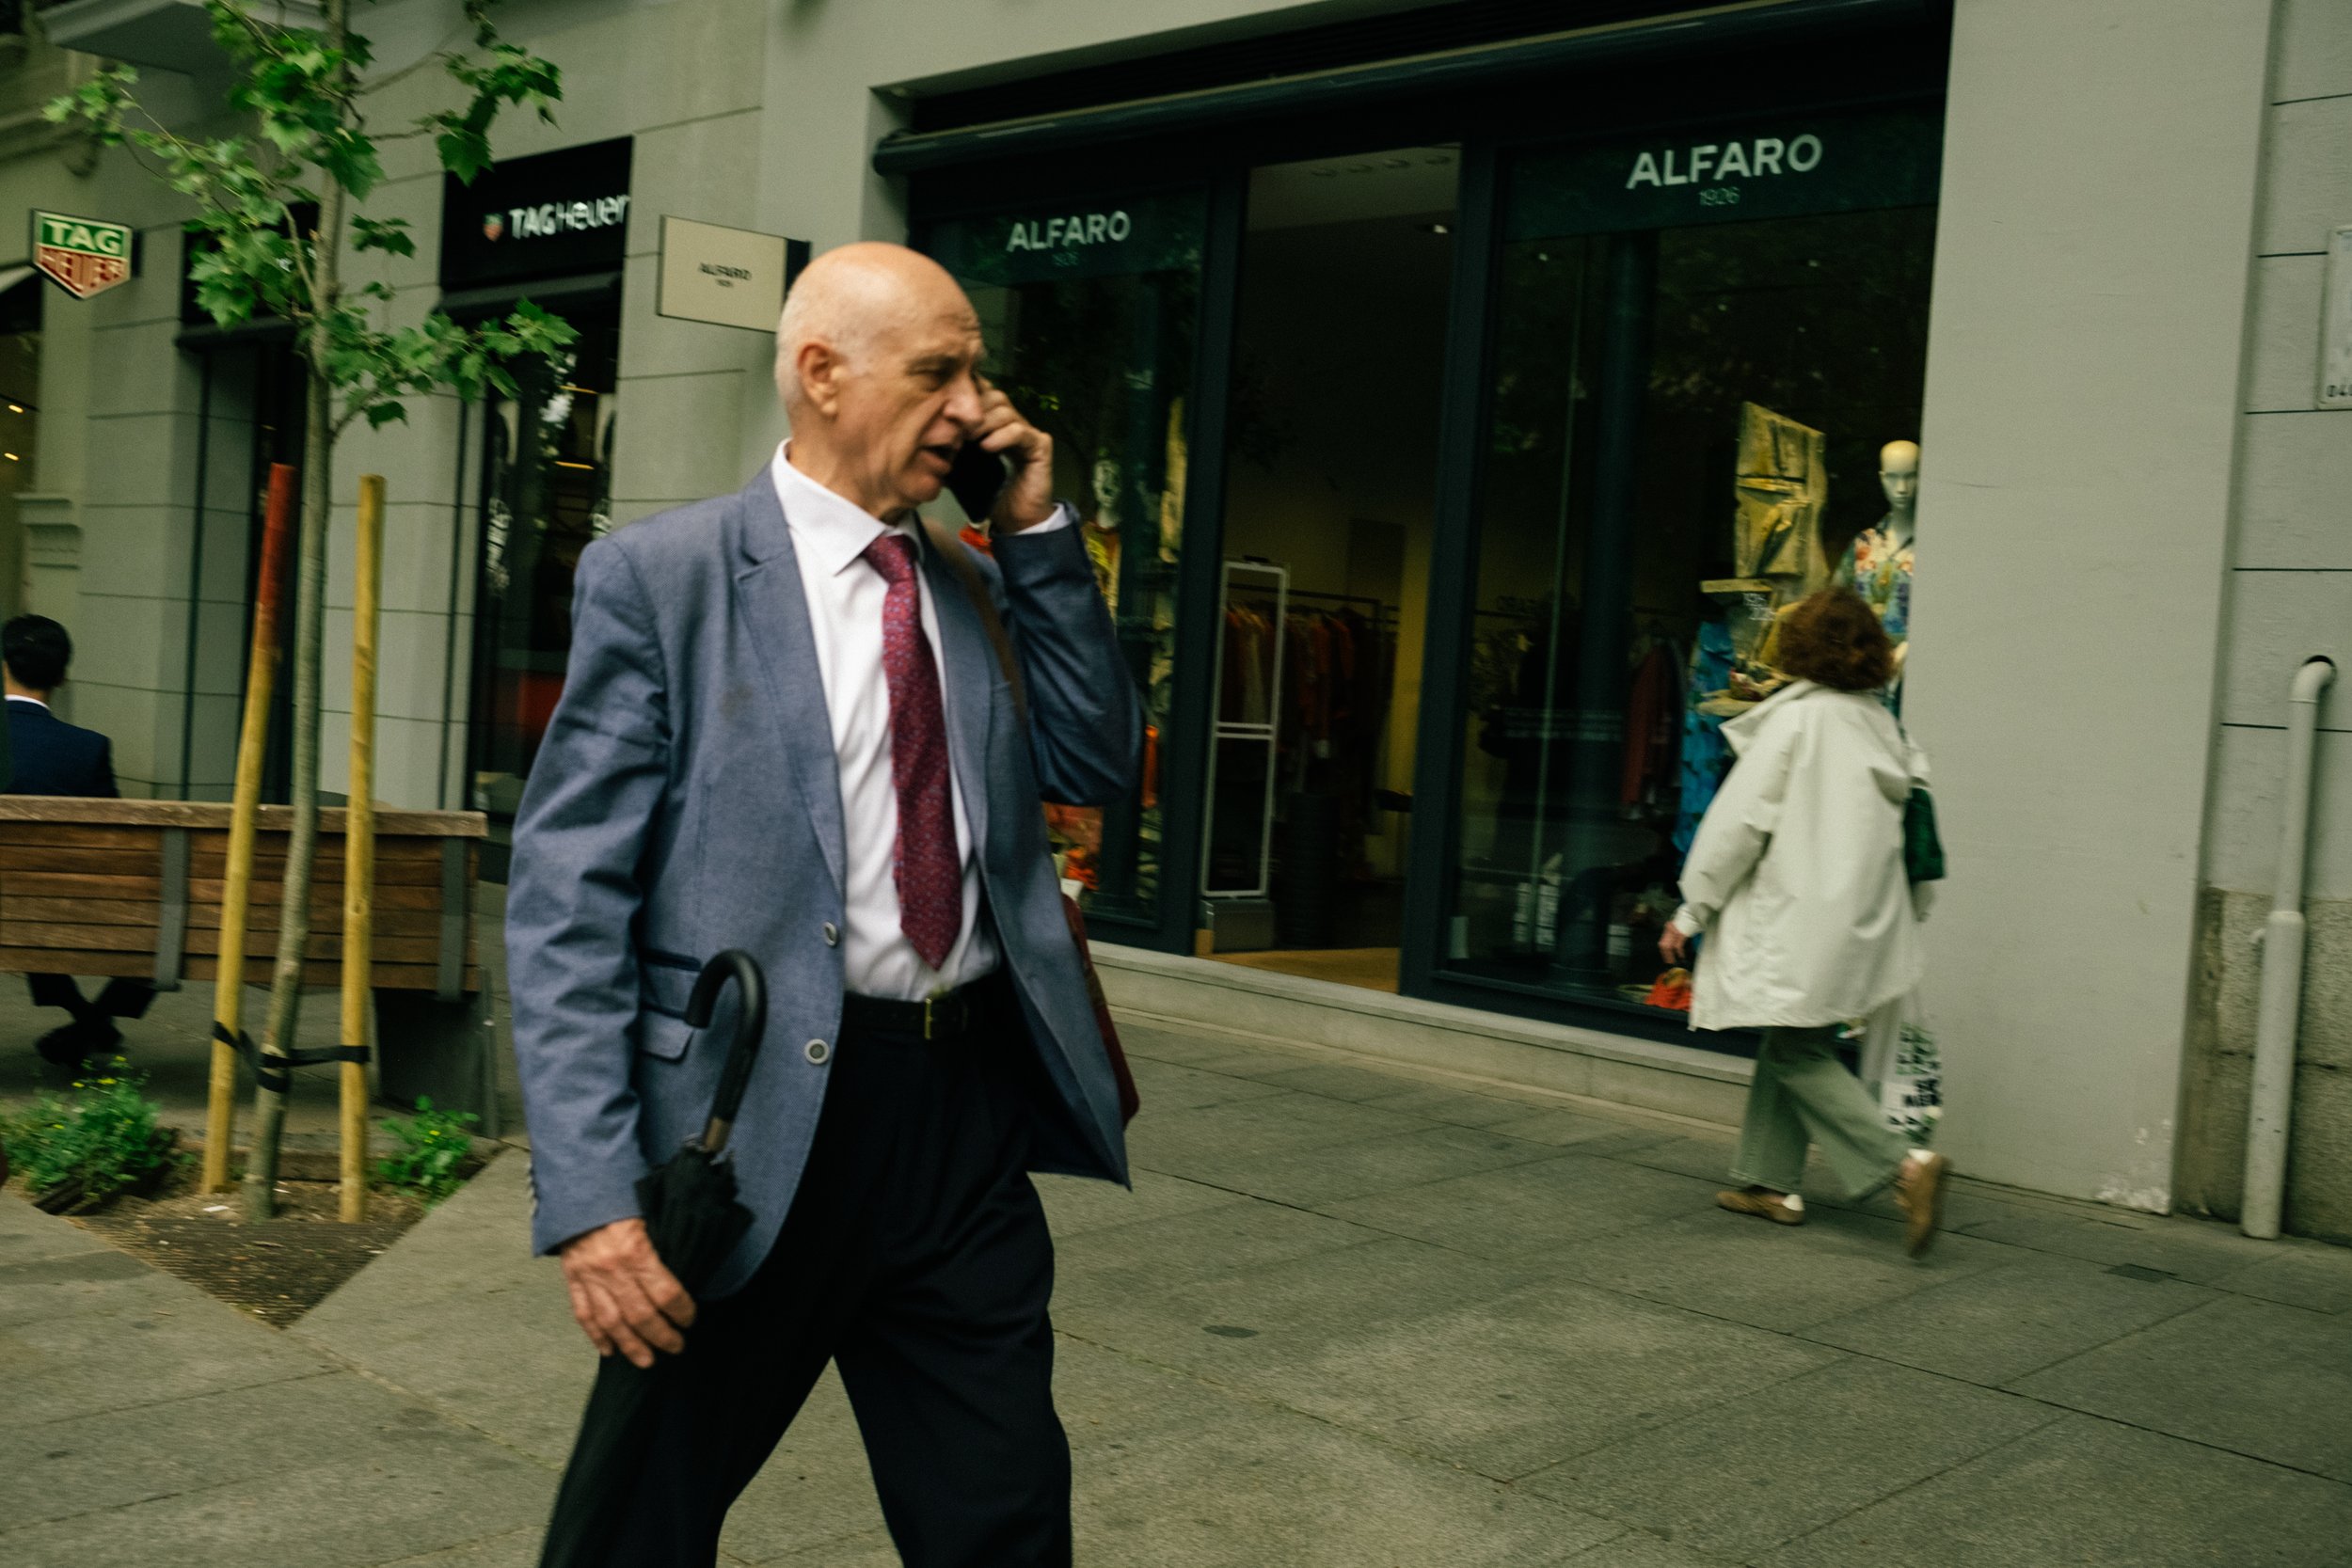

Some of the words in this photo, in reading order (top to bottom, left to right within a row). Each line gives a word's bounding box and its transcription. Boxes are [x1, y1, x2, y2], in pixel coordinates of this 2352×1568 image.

[1626, 134, 1823, 189] ALFARO
[44, 219, 120, 254] TAG
[1006, 210, 1131, 252] ALFARO
